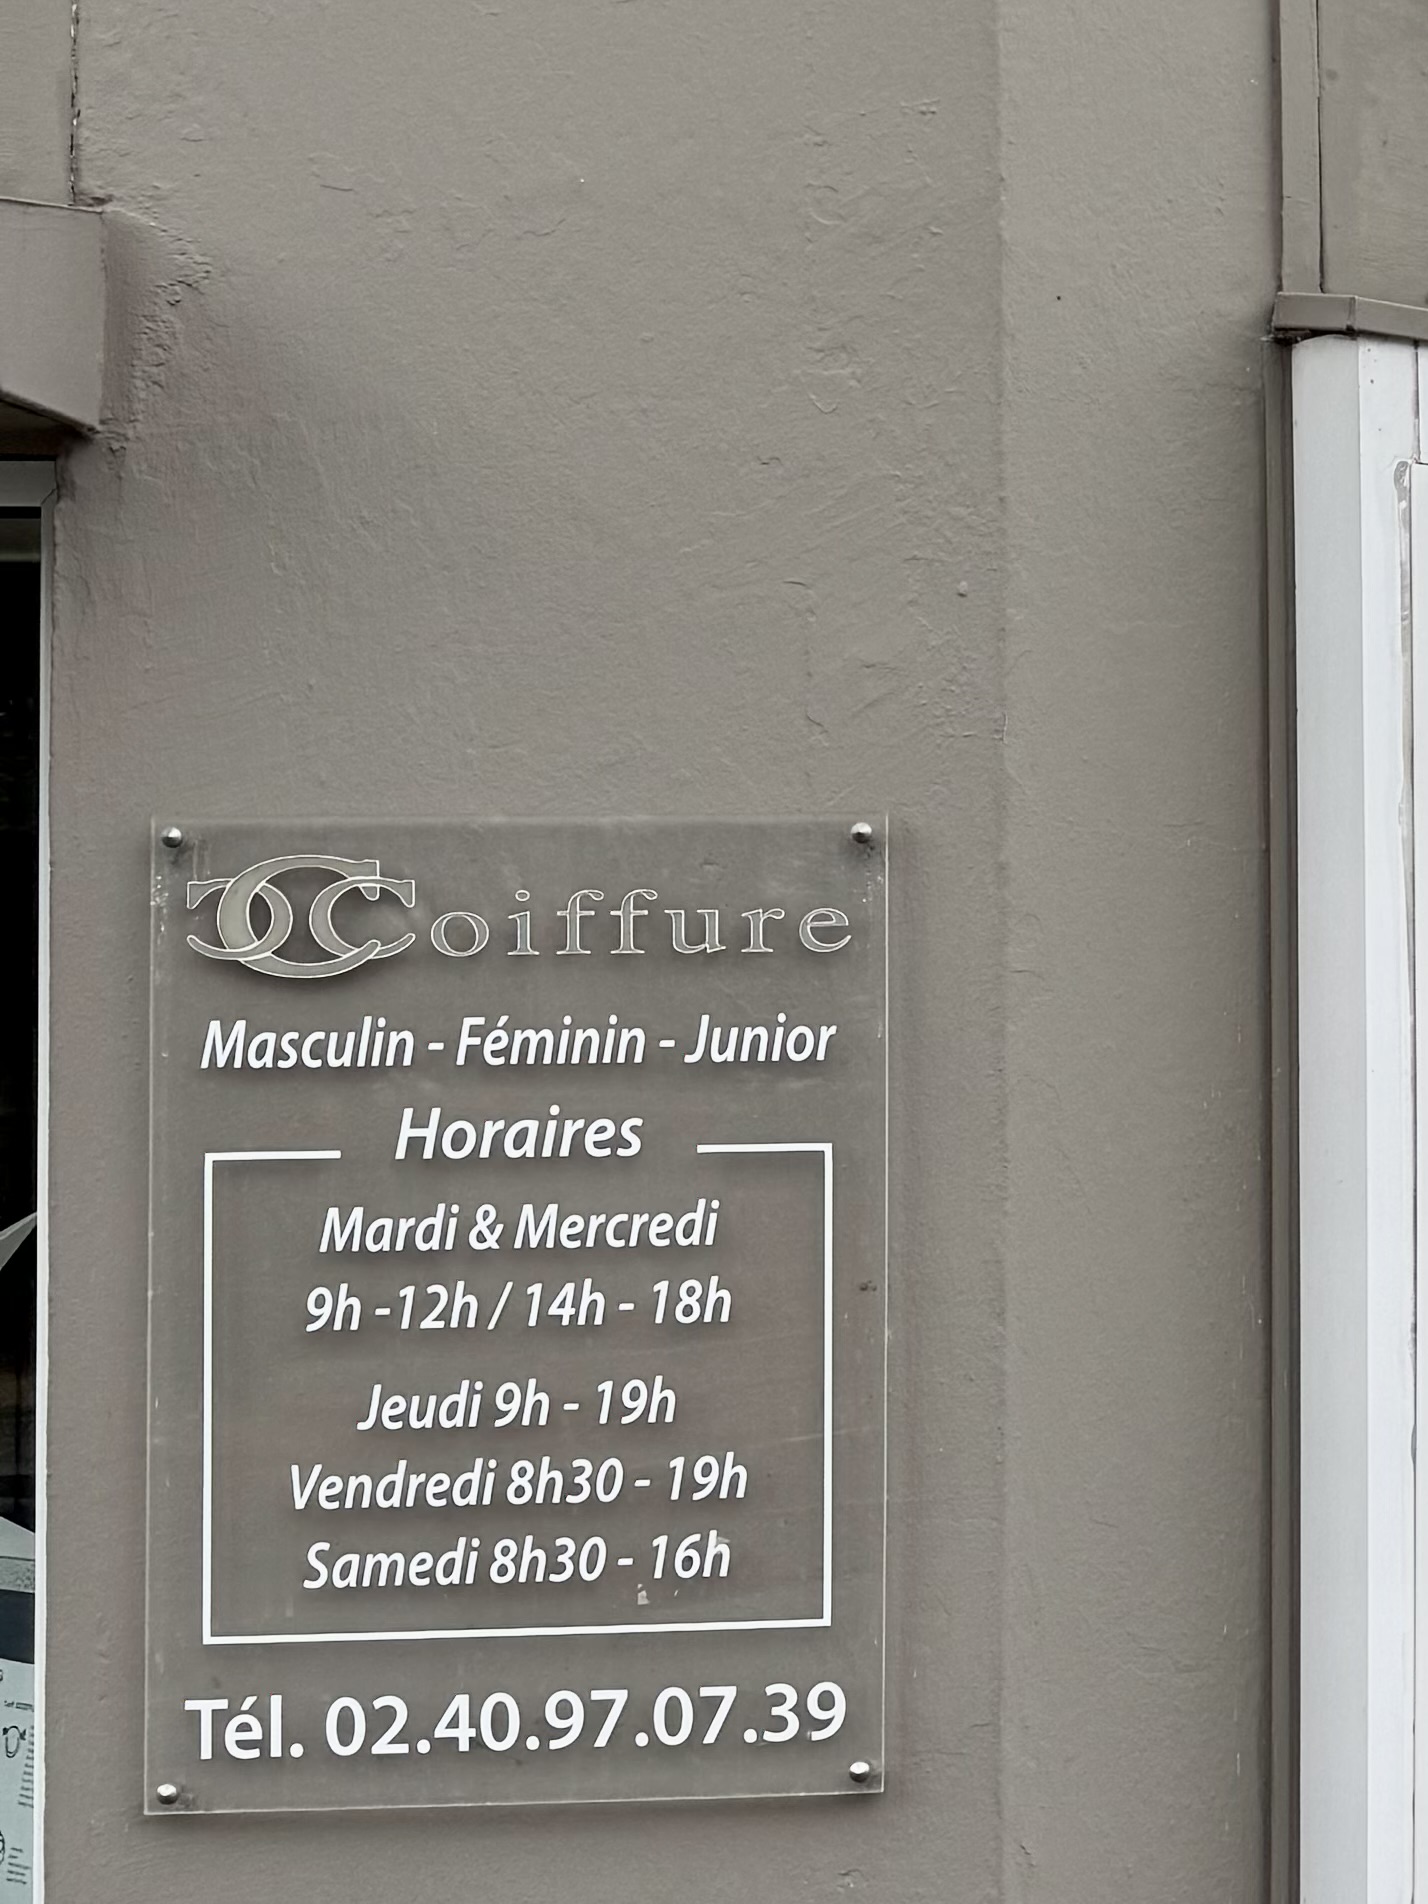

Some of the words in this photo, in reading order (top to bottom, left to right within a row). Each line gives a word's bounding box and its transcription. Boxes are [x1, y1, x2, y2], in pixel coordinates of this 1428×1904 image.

[200, 1015, 414, 1069] Masculin
[456, 1015, 646, 1067] Féminin
[684, 1012, 837, 1064] Junior
[395, 1104, 643, 1160] Horaires
[319, 1203, 460, 1253] Mardi
[468, 1203, 504, 1250] &
[513, 1198, 720, 1249] Mercredi
[306, 1283, 361, 1332] 9h
[488, 1281, 514, 1330] /
[526, 1278, 605, 1327] 14h
[653, 1275, 731, 1325] 18h
[356, 1379, 484, 1431] Jeudi
[494, 1378, 550, 1427] 9h
[597, 1375, 676, 1425] 19h
[291, 1457, 497, 1510] Vendredi
[506, 1456, 624, 1505] 8h30
[669, 1451, 748, 1501] 19h
[303, 1536, 480, 1589] Samedi
[489, 1535, 607, 1584] 8h30
[652, 1529, 730, 1580] 16h
[184, 1694, 304, 1760] Tél.
[325, 1681, 847, 1756] 02.40.97.07.39
